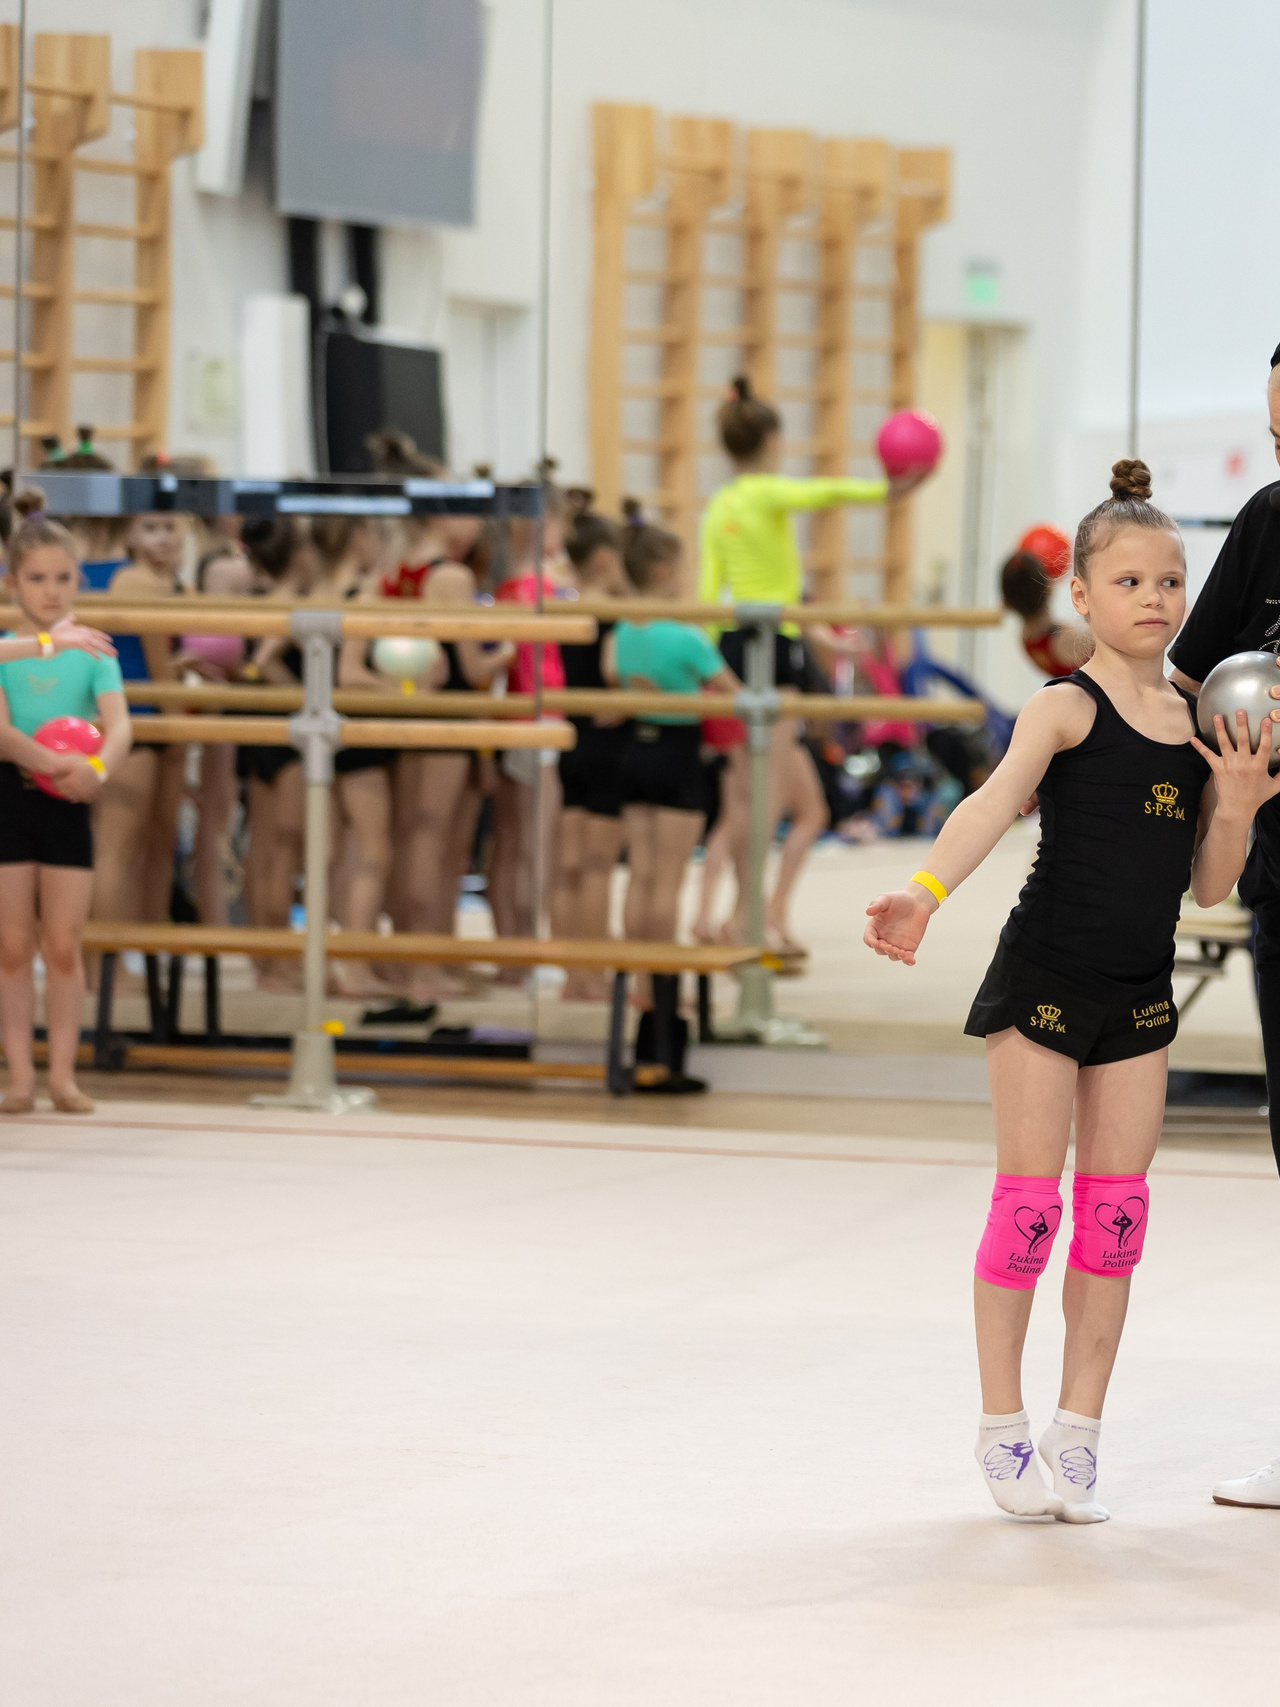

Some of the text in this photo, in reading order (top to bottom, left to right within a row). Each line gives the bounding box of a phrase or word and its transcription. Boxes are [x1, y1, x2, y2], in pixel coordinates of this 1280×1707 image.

[1132, 1000, 1171, 1019] Lukina
[1008, 1252, 1044, 1265] Lukina
[1101, 1248, 1138, 1259] Lukina
[1006, 1262, 1041, 1275] Polina
[1101, 1257, 1136, 1268] Polina
